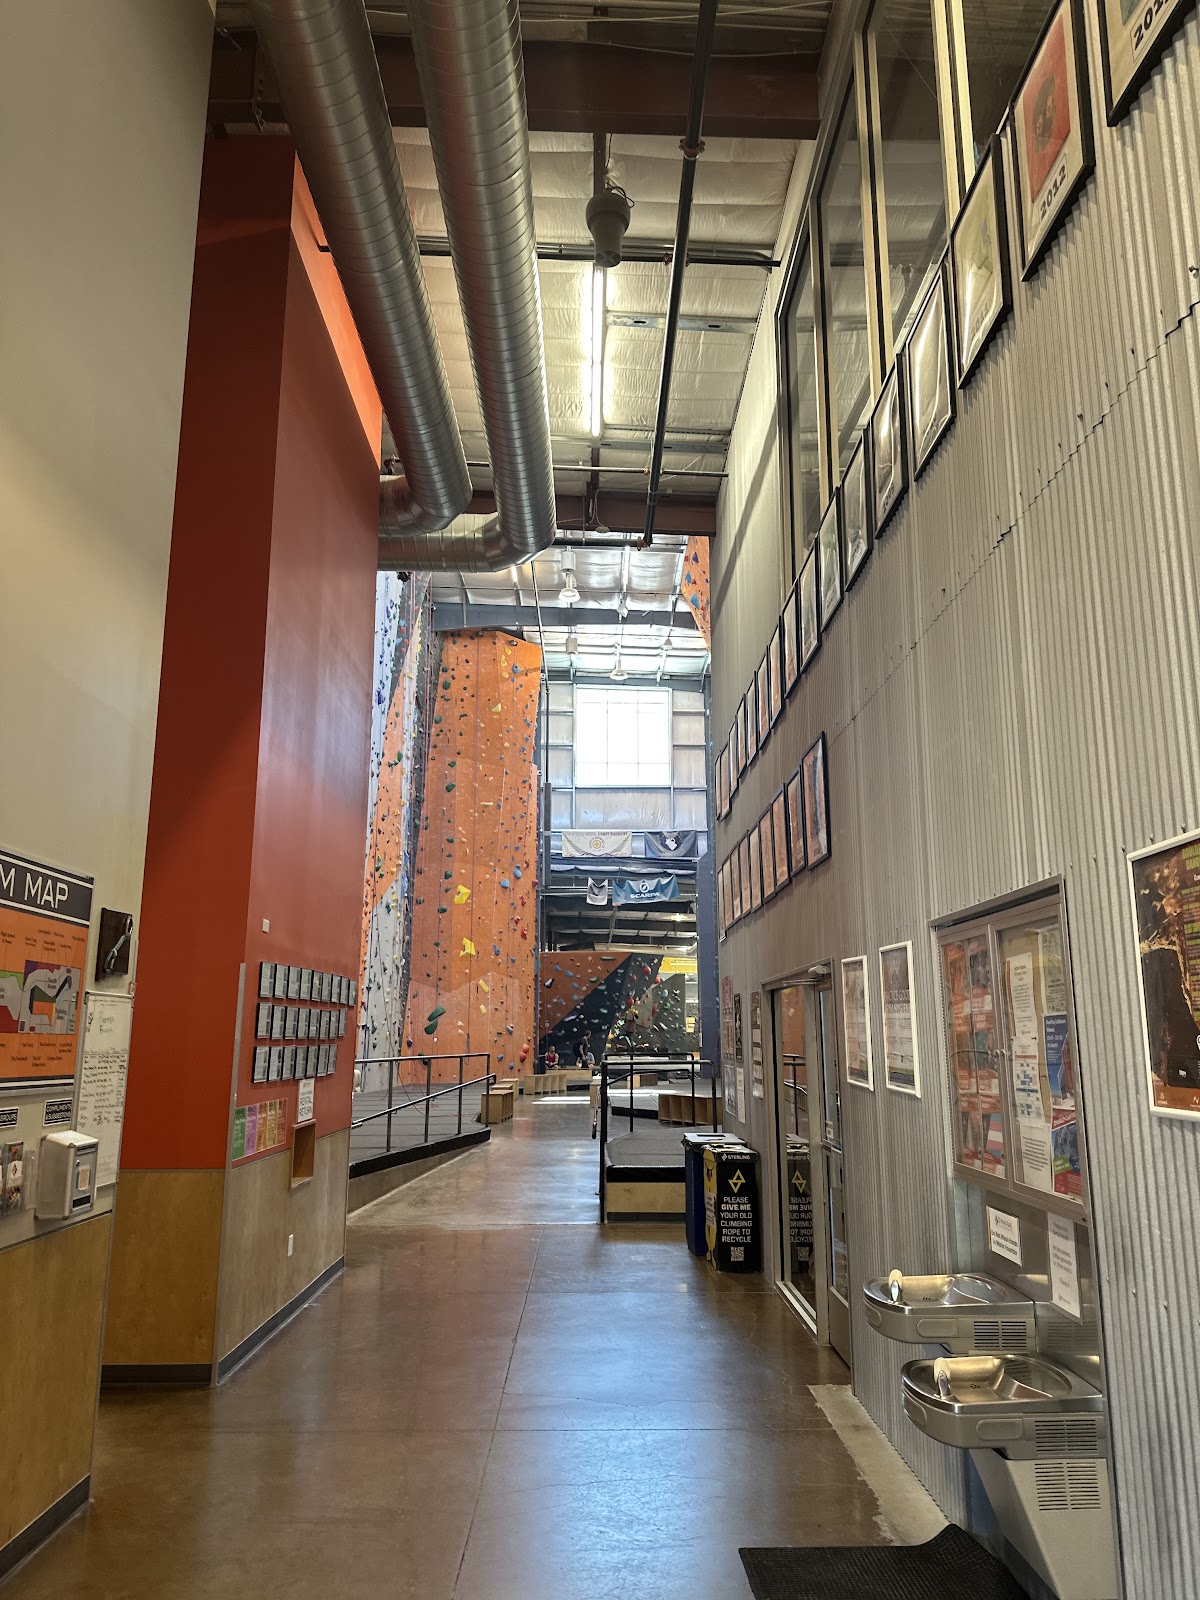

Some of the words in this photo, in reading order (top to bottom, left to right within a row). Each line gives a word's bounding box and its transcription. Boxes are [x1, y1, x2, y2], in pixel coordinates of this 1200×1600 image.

[1133, 0, 1173, 50] 201
[1040, 164, 1066, 221] 2012
[25, 872, 69, 909] MAP
[630, 891, 660, 899] SCARPA
[0, 1113, 17, 1121] GROUPS
